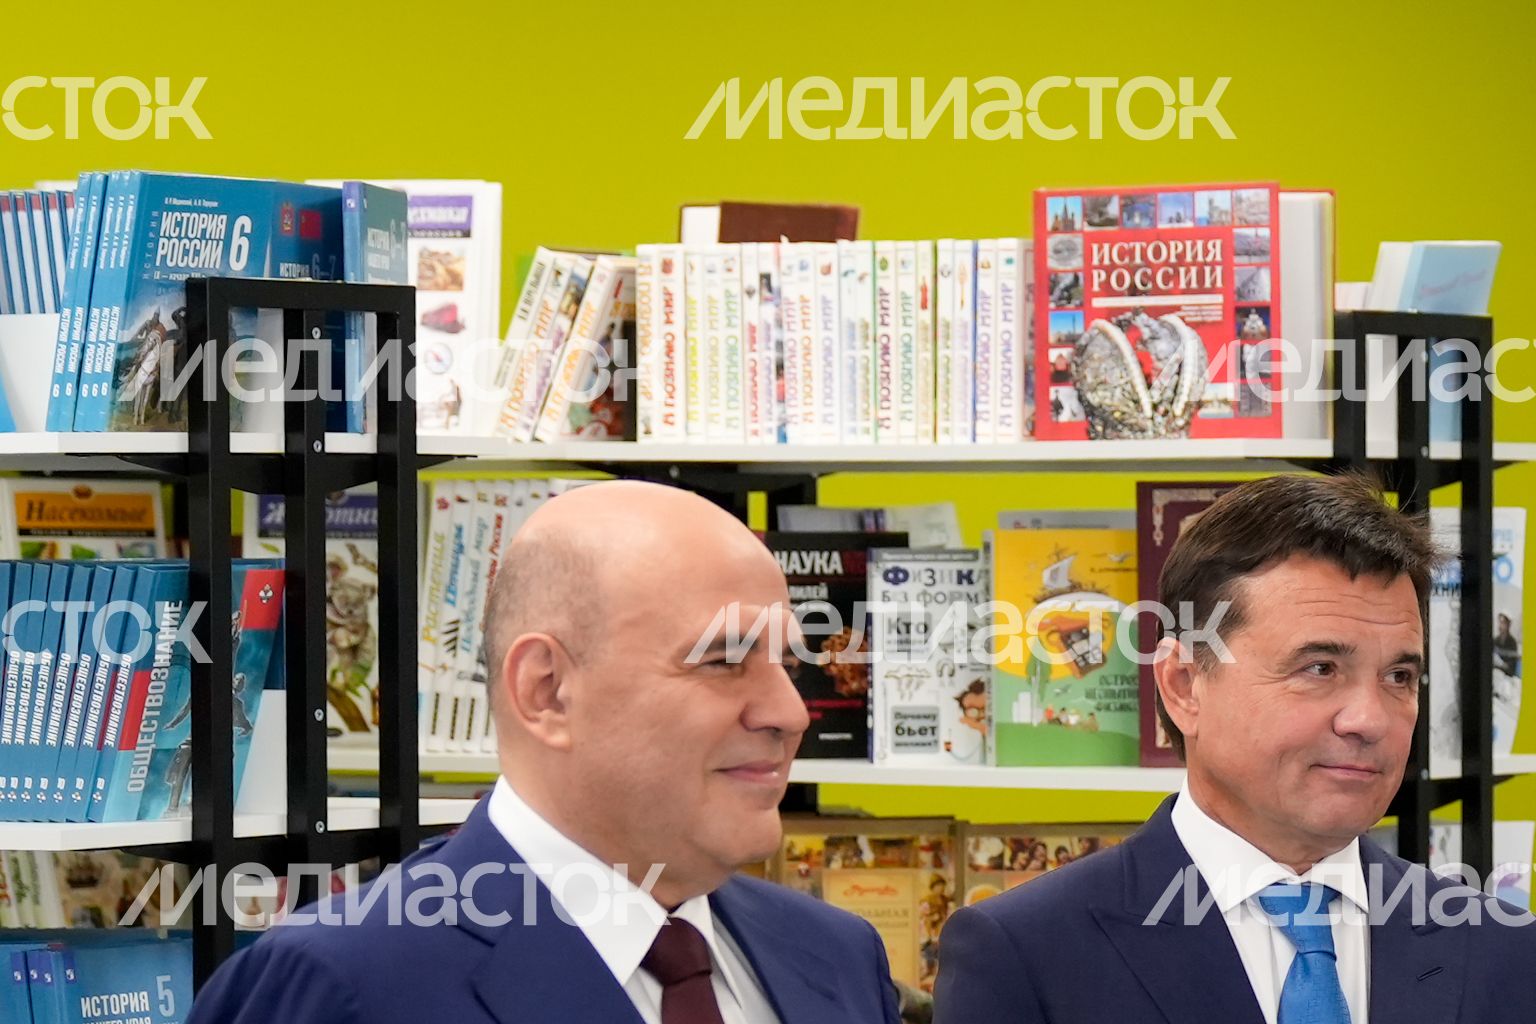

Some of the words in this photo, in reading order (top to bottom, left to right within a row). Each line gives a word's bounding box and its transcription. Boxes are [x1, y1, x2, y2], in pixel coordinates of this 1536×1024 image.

[160, 212, 227, 239] ИСТОРИЯ
[156, 238, 223, 268] РОССИИ
[229, 215, 252, 271] 6
[1092, 239, 1222, 266] ИСТОРИЯ
[280, 262, 310, 278] ИСТОРИЯ
[1092, 266, 1223, 292] РОССИИ
[59, 308, 71, 342] ИСТОРИЯ
[72, 307, 83, 340] ИСТОРИЯ
[88, 308, 100, 342] ИСТОРИЯ
[99, 307, 110, 341] ИСТОРИЯ
[108, 306, 120, 340] ИСТОРИЯ
[55, 344, 66, 374] РОССИИ
[68, 342, 79, 372] РОССИИ
[84, 344, 95, 374] РОССИИ
[94, 343, 105, 373] РОССИИ
[103, 342, 115, 372] РОССИИ
[53, 384, 59, 397] 6
[66, 383, 72, 396] 6
[82, 384, 88, 397] 6
[92, 384, 98, 396] 6
[101, 383, 108, 396] 6
[2, 651, 20, 745] ОБЩЕСТВОЗНАНИЕ
[15, 652, 34, 746] ОБЩЕСТВОЗНАНИЕ
[29, 652, 51, 746] ОБЩЕСТВОЗНАНИЕ
[46, 653, 71, 747] ОБЩЕСТВОЗНАНИЕ
[64, 654, 91, 747] ОБЩЕСТВОЗНАНИЕ
[83, 654, 111, 747] ОБЩЕСТВОЗНАНИЕ
[104, 654, 132, 747] ОБЩЕСТВОЗНАНИЕ
[126, 601, 183, 793] ОБЩЕСТВОЗНАНИЕ
[81, 991, 150, 1018] ИСТОРИЯ
[156, 975, 174, 1017] 5
